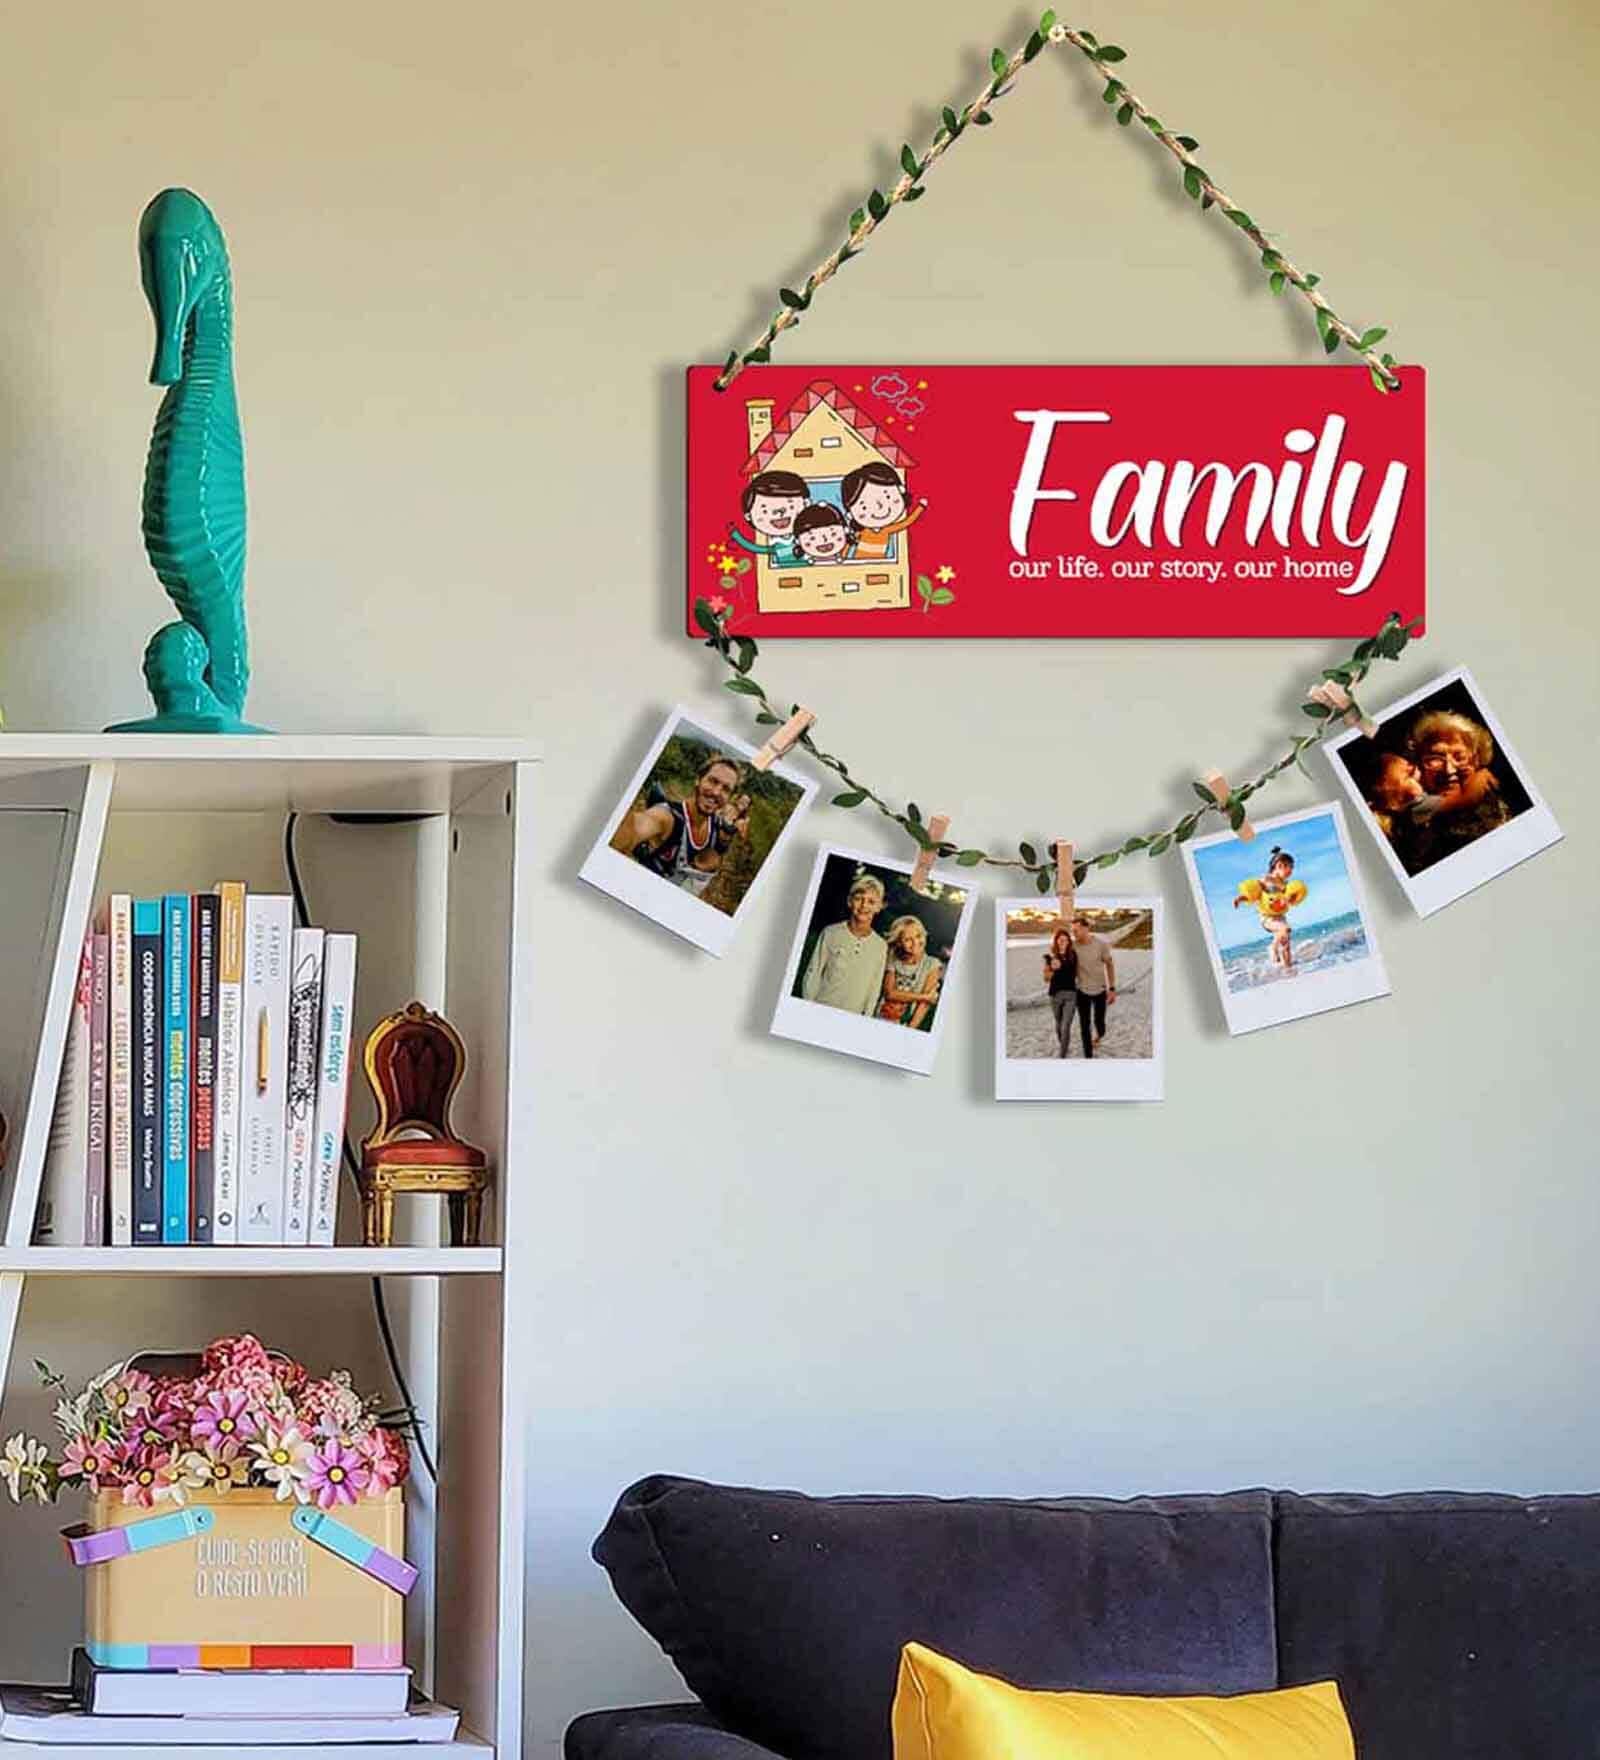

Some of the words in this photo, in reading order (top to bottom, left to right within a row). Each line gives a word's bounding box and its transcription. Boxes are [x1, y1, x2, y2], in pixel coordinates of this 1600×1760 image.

[1008, 408, 1408, 595] Family
[1009, 560, 1049, 578] our
[1058, 555, 1105, 578] life.
[1111, 560, 1153, 578] our
[1160, 559, 1227, 583] story.
[1233, 560, 1275, 578] our
[1283, 555, 1354, 578] home
[143, 951, 155, 1044] CODEPENDÊNCIA
[331, 1004, 345, 1032] sem
[143, 1046, 155, 1086] NUNCA
[170, 1029, 184, 1080] mentes
[198, 1036, 213, 1085] mentes
[325, 1033, 344, 1082] esforço
[143, 1087, 154, 1117] MAIS
[168, 1081, 184, 1160] depressivas
[197, 1086, 212, 1151] perigosas
[221, 1130, 232, 1167] James
[221, 1169, 231, 1200] Clear
[196, 1570, 208, 1598] O
